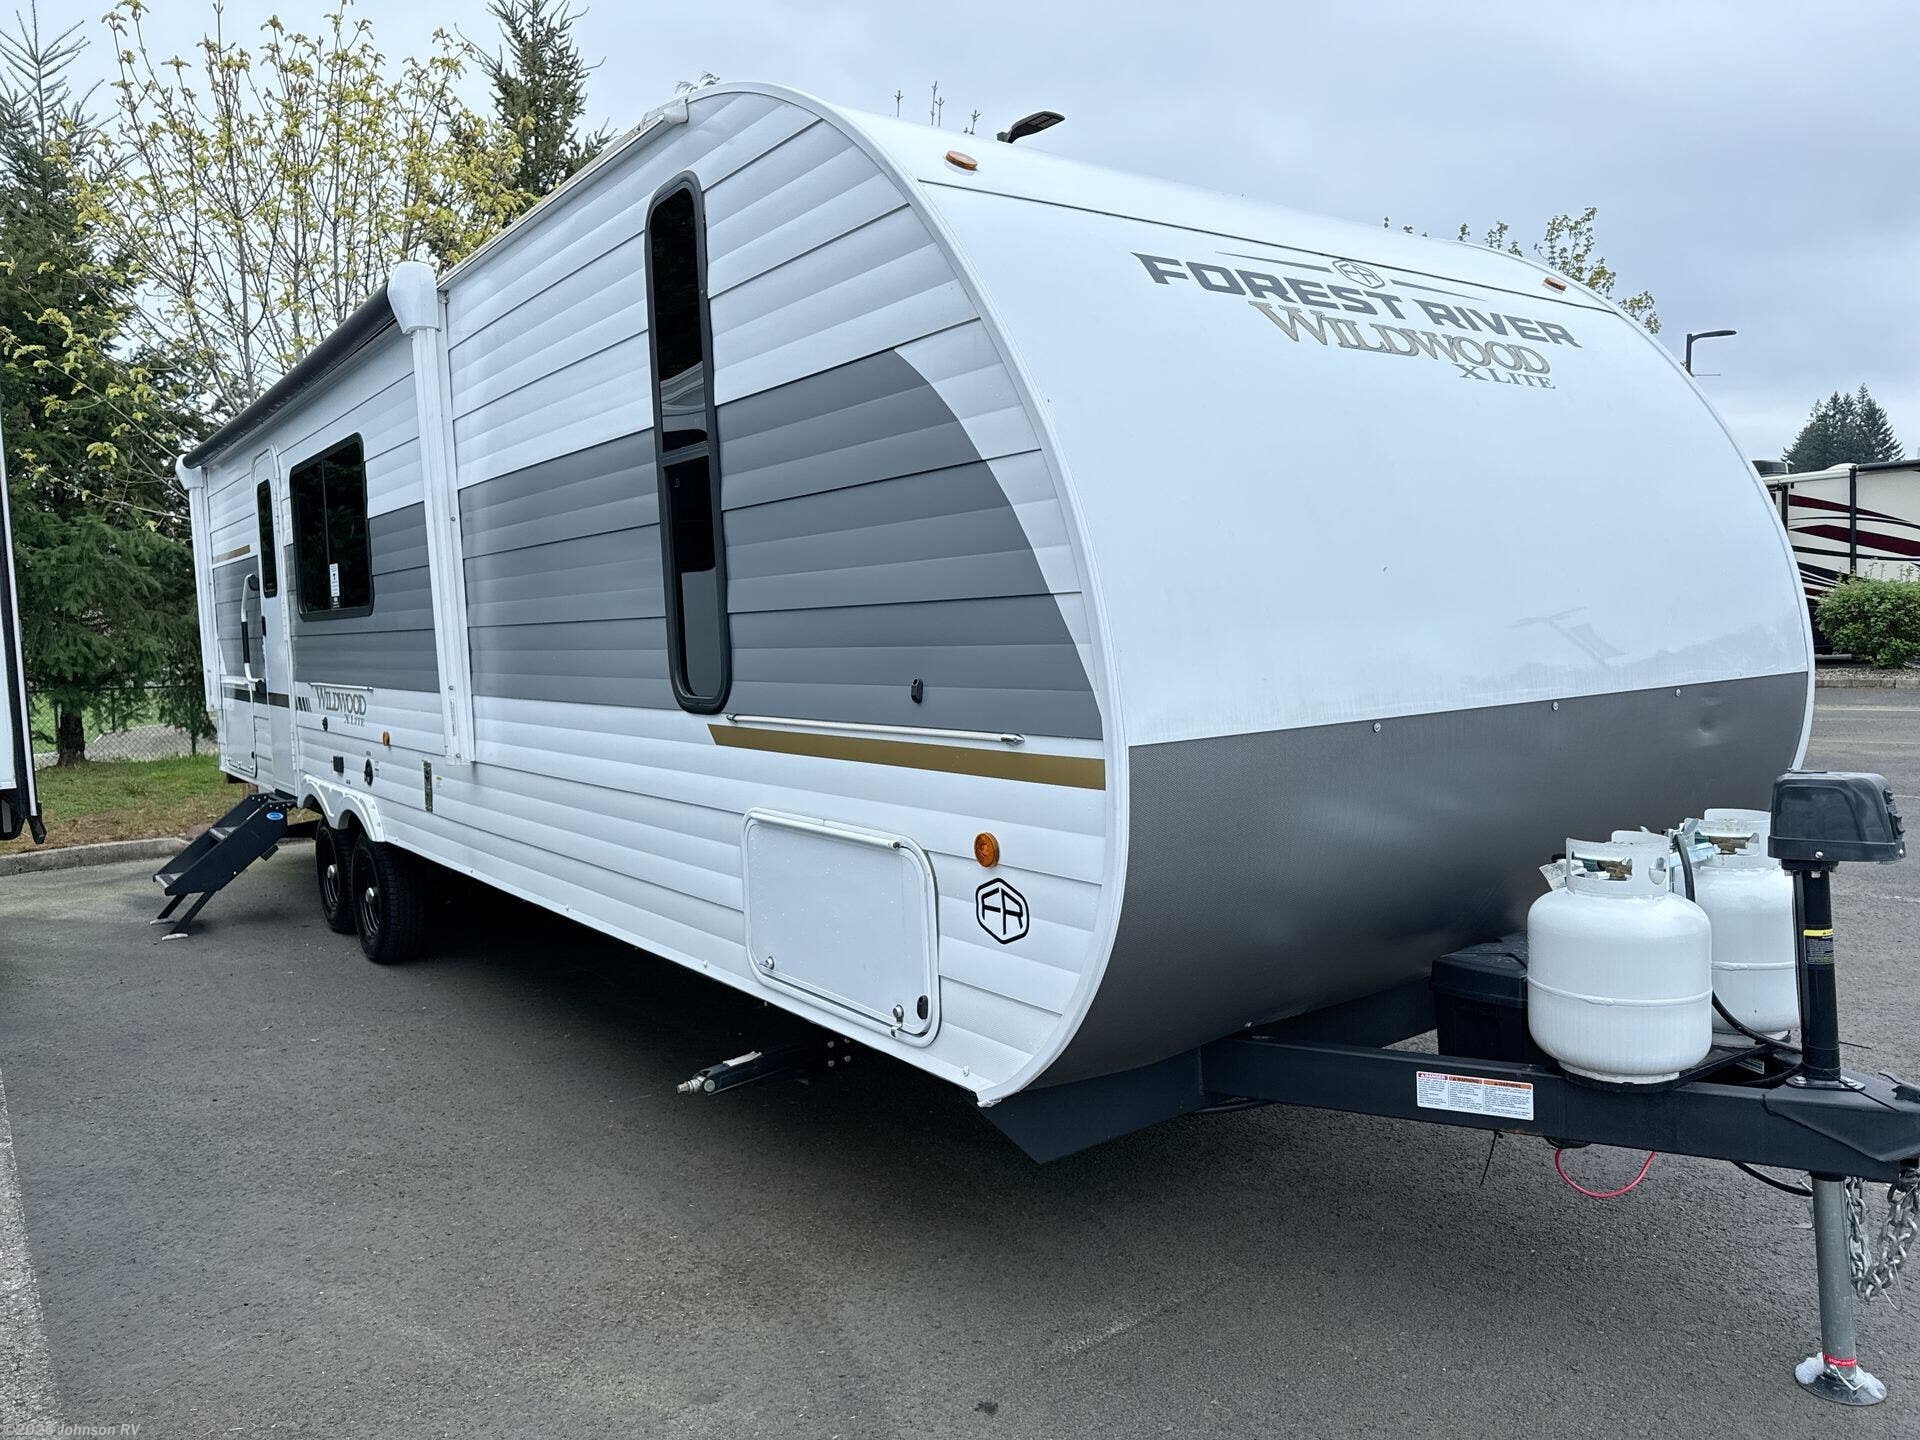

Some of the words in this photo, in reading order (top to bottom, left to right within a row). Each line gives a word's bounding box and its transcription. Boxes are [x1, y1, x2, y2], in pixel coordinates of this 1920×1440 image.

[1130, 251, 1405, 320] FOREST
[1411, 298, 1583, 348] RIVER
[1248, 301, 1551, 374] WILDWOOD
[315, 687, 366, 715] WILDWOOD
